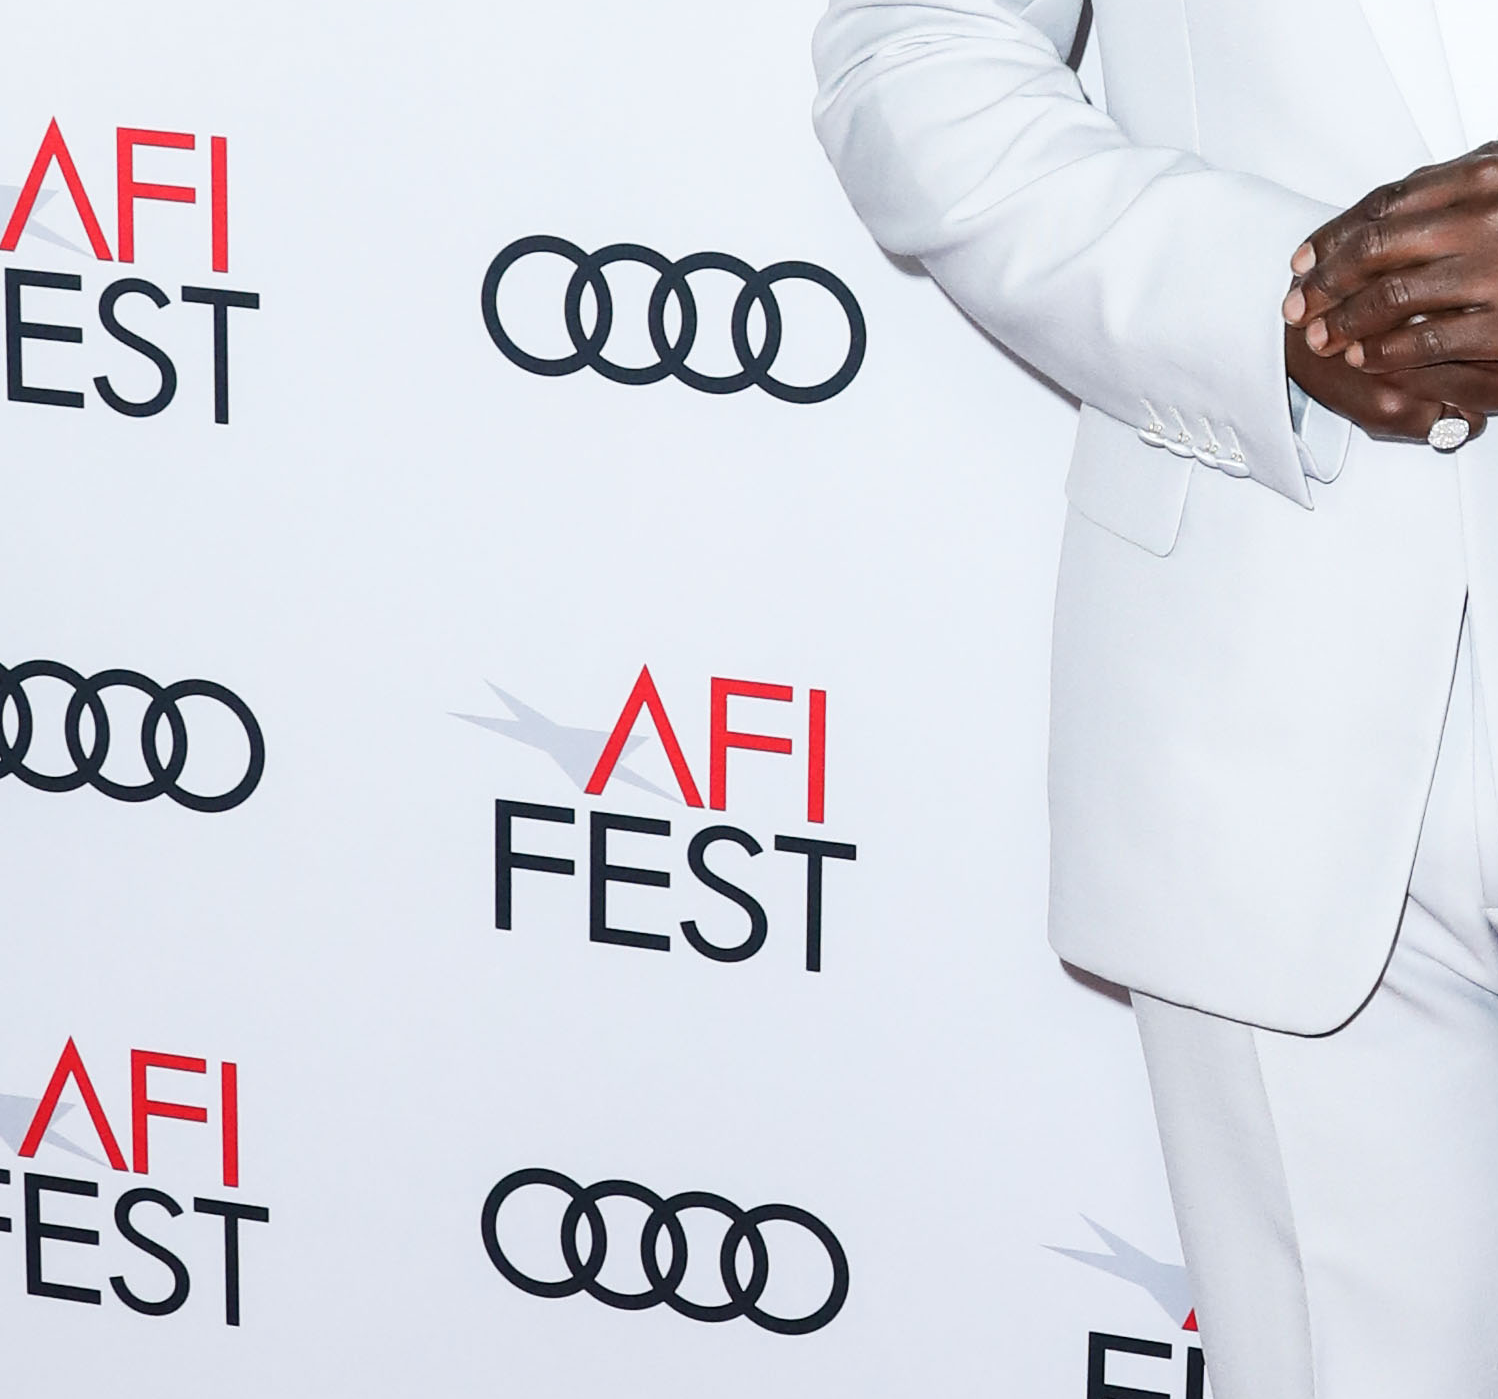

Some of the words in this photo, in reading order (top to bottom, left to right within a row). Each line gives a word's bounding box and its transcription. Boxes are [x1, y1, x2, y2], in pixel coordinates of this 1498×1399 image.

[0, 117, 228, 273] AFI
[585, 665, 826, 823] AFI
[495, 799, 857, 972] FEST
[18, 1036, 238, 1187] AFI
[0, 1168, 270, 1327] EST
